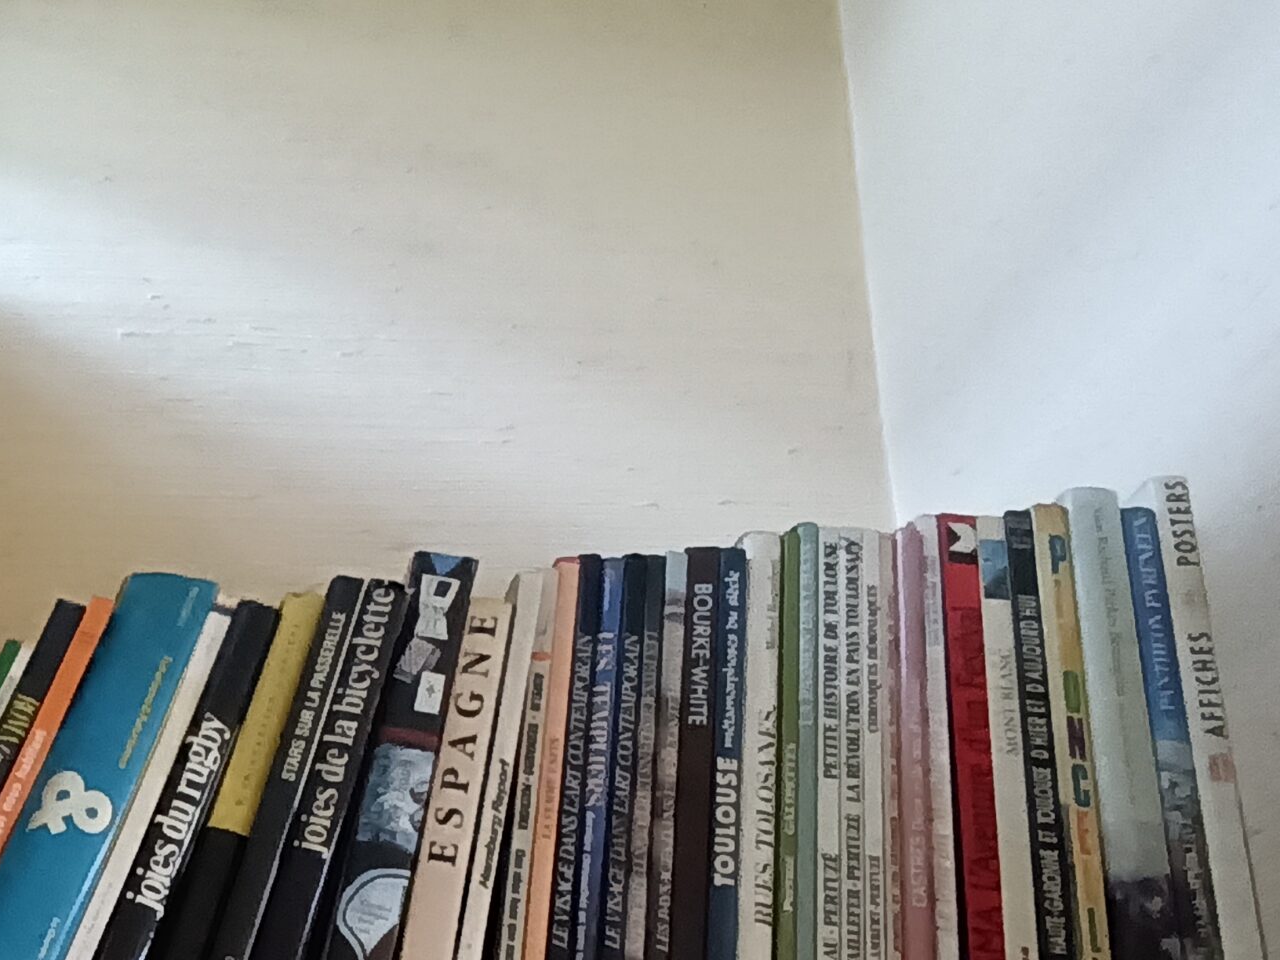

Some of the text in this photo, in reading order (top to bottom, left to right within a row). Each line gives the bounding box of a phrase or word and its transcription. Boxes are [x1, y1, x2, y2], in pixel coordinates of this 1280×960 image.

[1161, 478, 1201, 570] POSTERS
[821, 542, 838, 614] TOULOUSE
[688, 583, 712, 724] BOURKE-WHITE
[821, 619, 838, 639] DE
[844, 631, 860, 663] PAYS
[280, 609, 347, 781] STARS SUR LA PASSERELLE
[294, 582, 395, 858] joies de la bicyclette
[586, 631, 615, 807] LES TEMPLIERS
[616, 633, 638, 765] CONTEMPORAIN
[821, 645, 838, 718] HISTOIRE
[1025, 698, 1045, 713] ET
[1186, 630, 1228, 742] AFFICHES
[426, 612, 497, 866] ESPAGNE
[821, 723, 837, 779] PETITE
[842, 690, 860, 778] RÉVOLUTION
[127, 712, 230, 920] joies du rugby
[488, 758, 513, 814] Report
[551, 632, 592, 948] LE VISAGE DANS L'ART CONTEMPORAIN
[710, 756, 739, 886] TOULOUSE
[844, 784, 860, 802] LA
[1030, 764, 1055, 825] TOULOUSE
[1036, 828, 1057, 844] ET
[609, 862, 624, 921] VISAGE
[751, 862, 775, 927] RUES
[1038, 848, 1067, 954] HAUTE-GARONNE
[607, 925, 620, 948] LE
